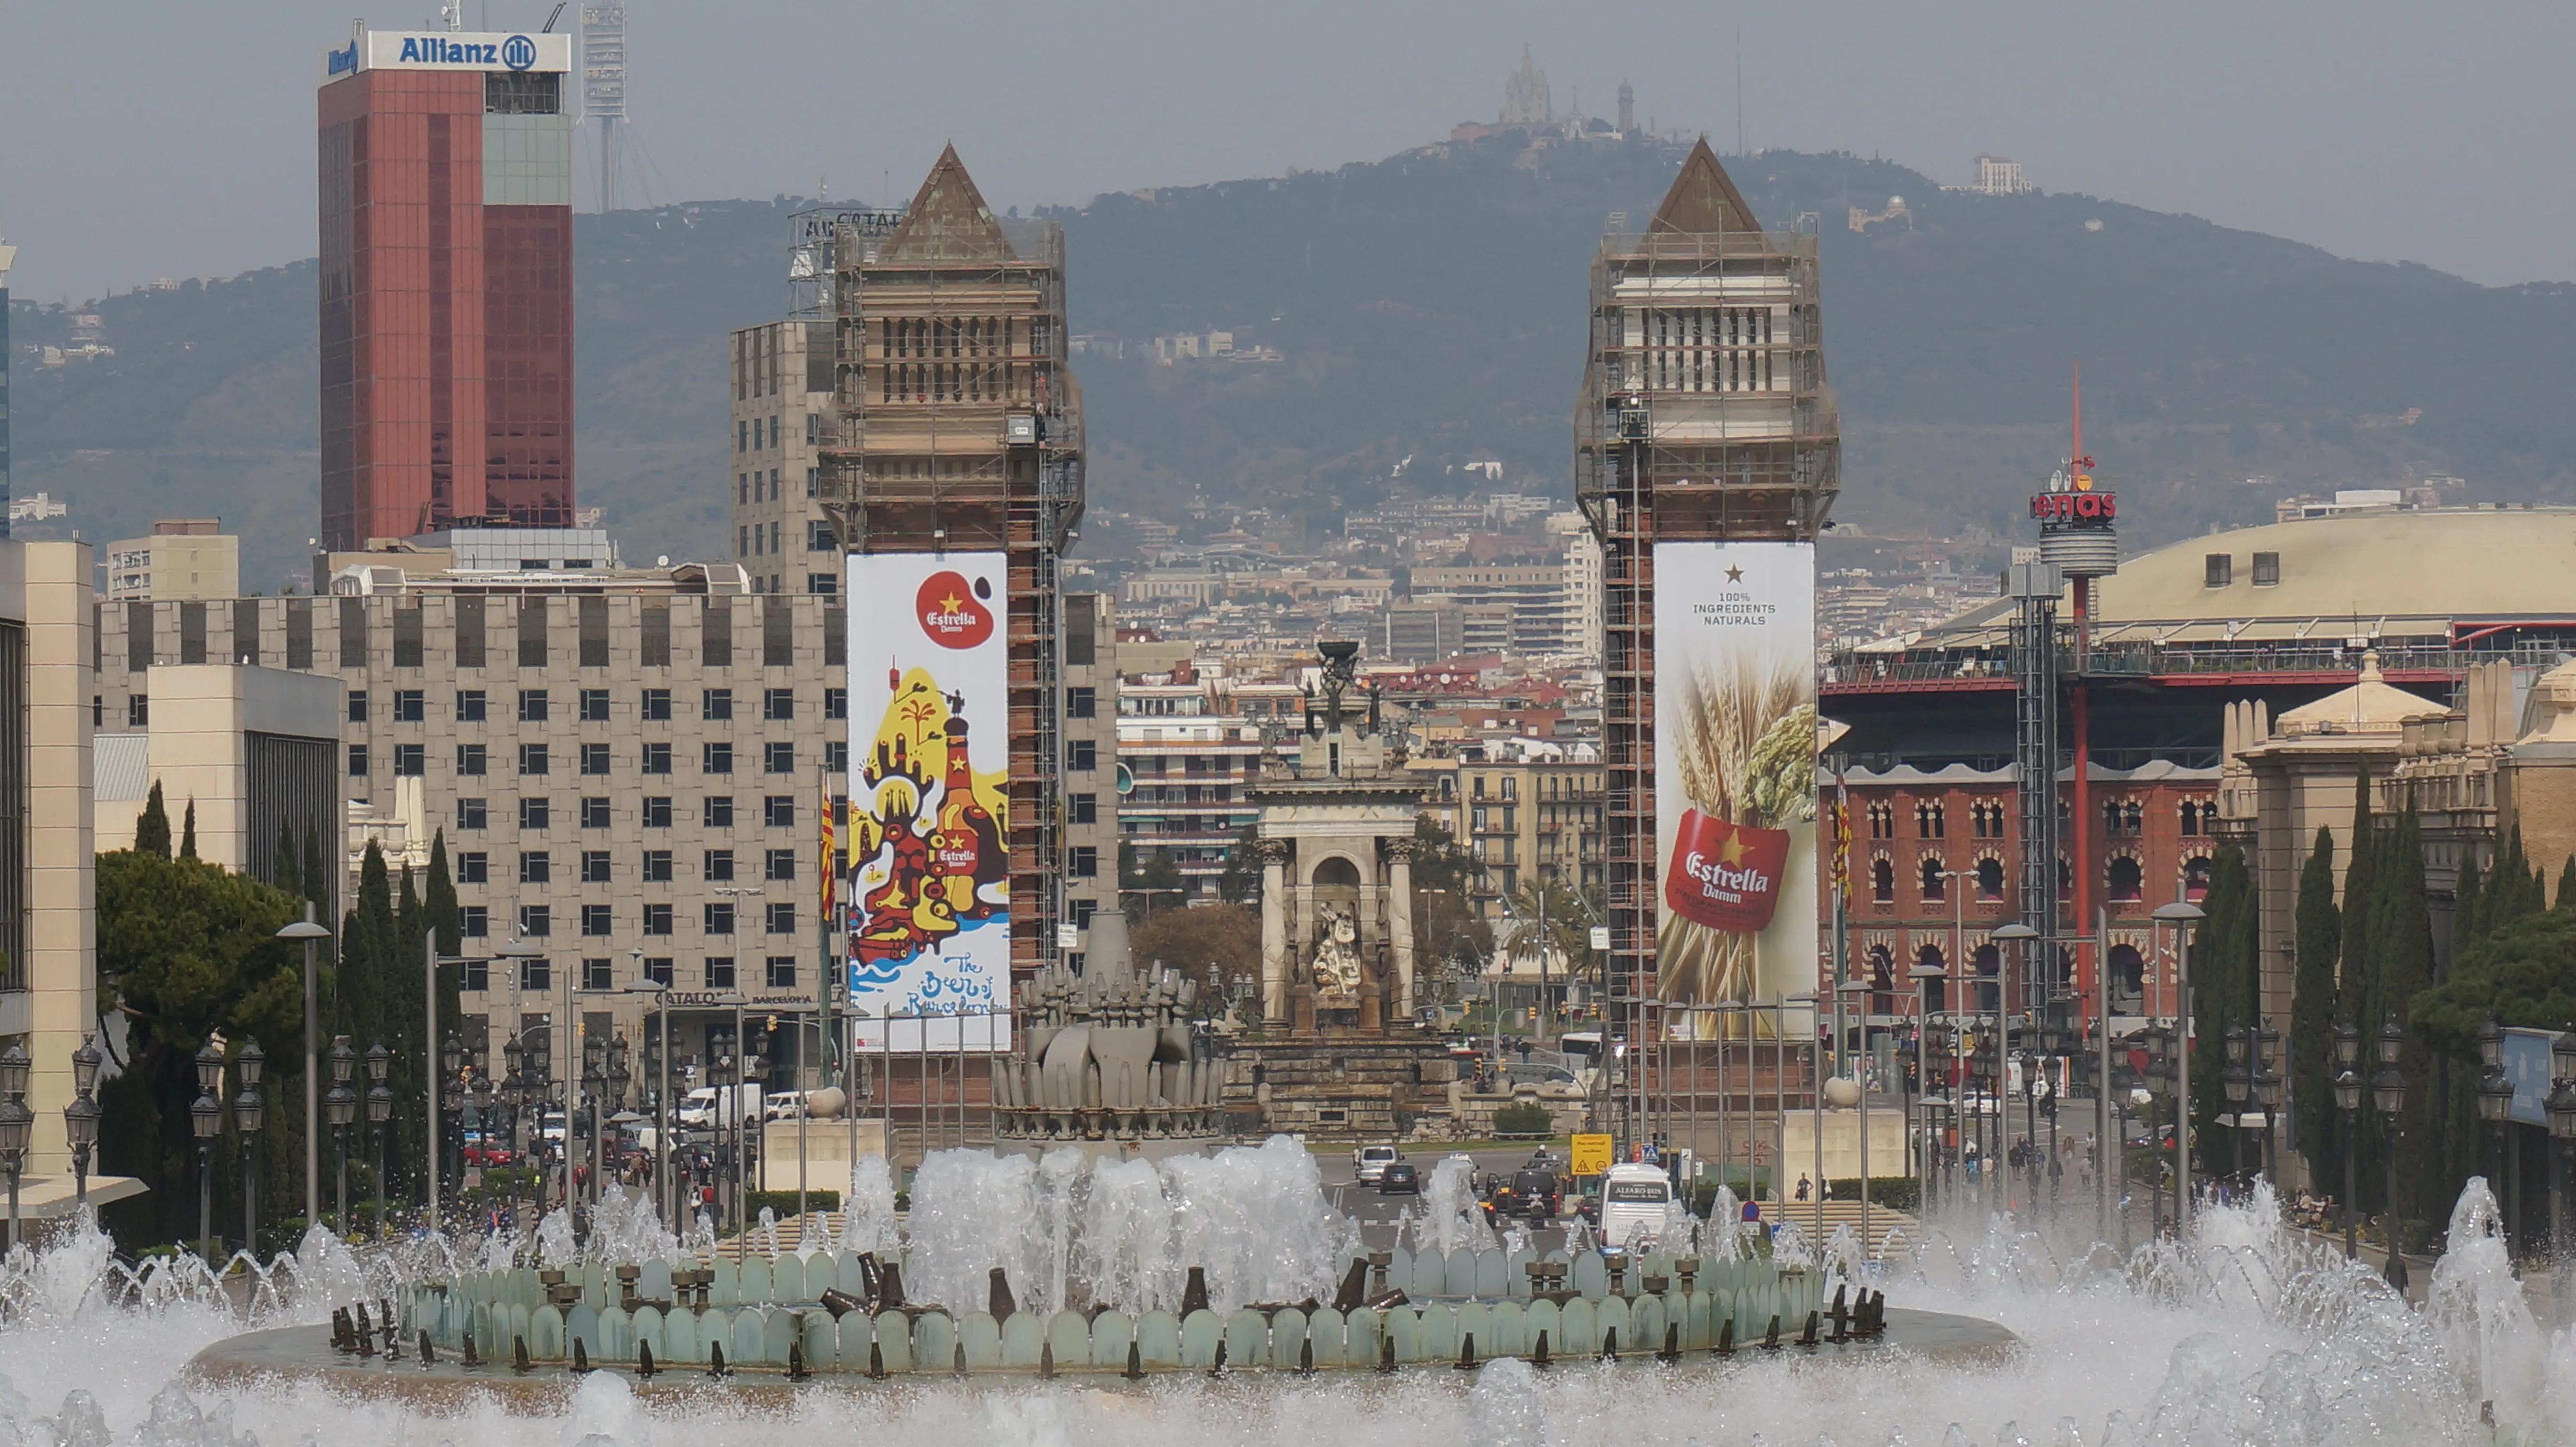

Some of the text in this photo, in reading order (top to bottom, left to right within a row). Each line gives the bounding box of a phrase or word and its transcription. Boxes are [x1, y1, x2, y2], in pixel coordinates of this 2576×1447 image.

[399, 38, 498, 63] Allianz
[1720, 593, 1750, 602] 100%
[1692, 604, 1776, 613] INGREDIENTS
[927, 612, 976, 625] Estrella
[1704, 616, 1766, 625] NATURALS
[939, 850, 975, 861] Estrella
[1686, 851, 1768, 892] Estrella
[1702, 883, 1741, 904] Damm
[943, 952, 983, 974] The
[921, 971, 993, 999] Beer of
[654, 992, 745, 1004] CATALO
